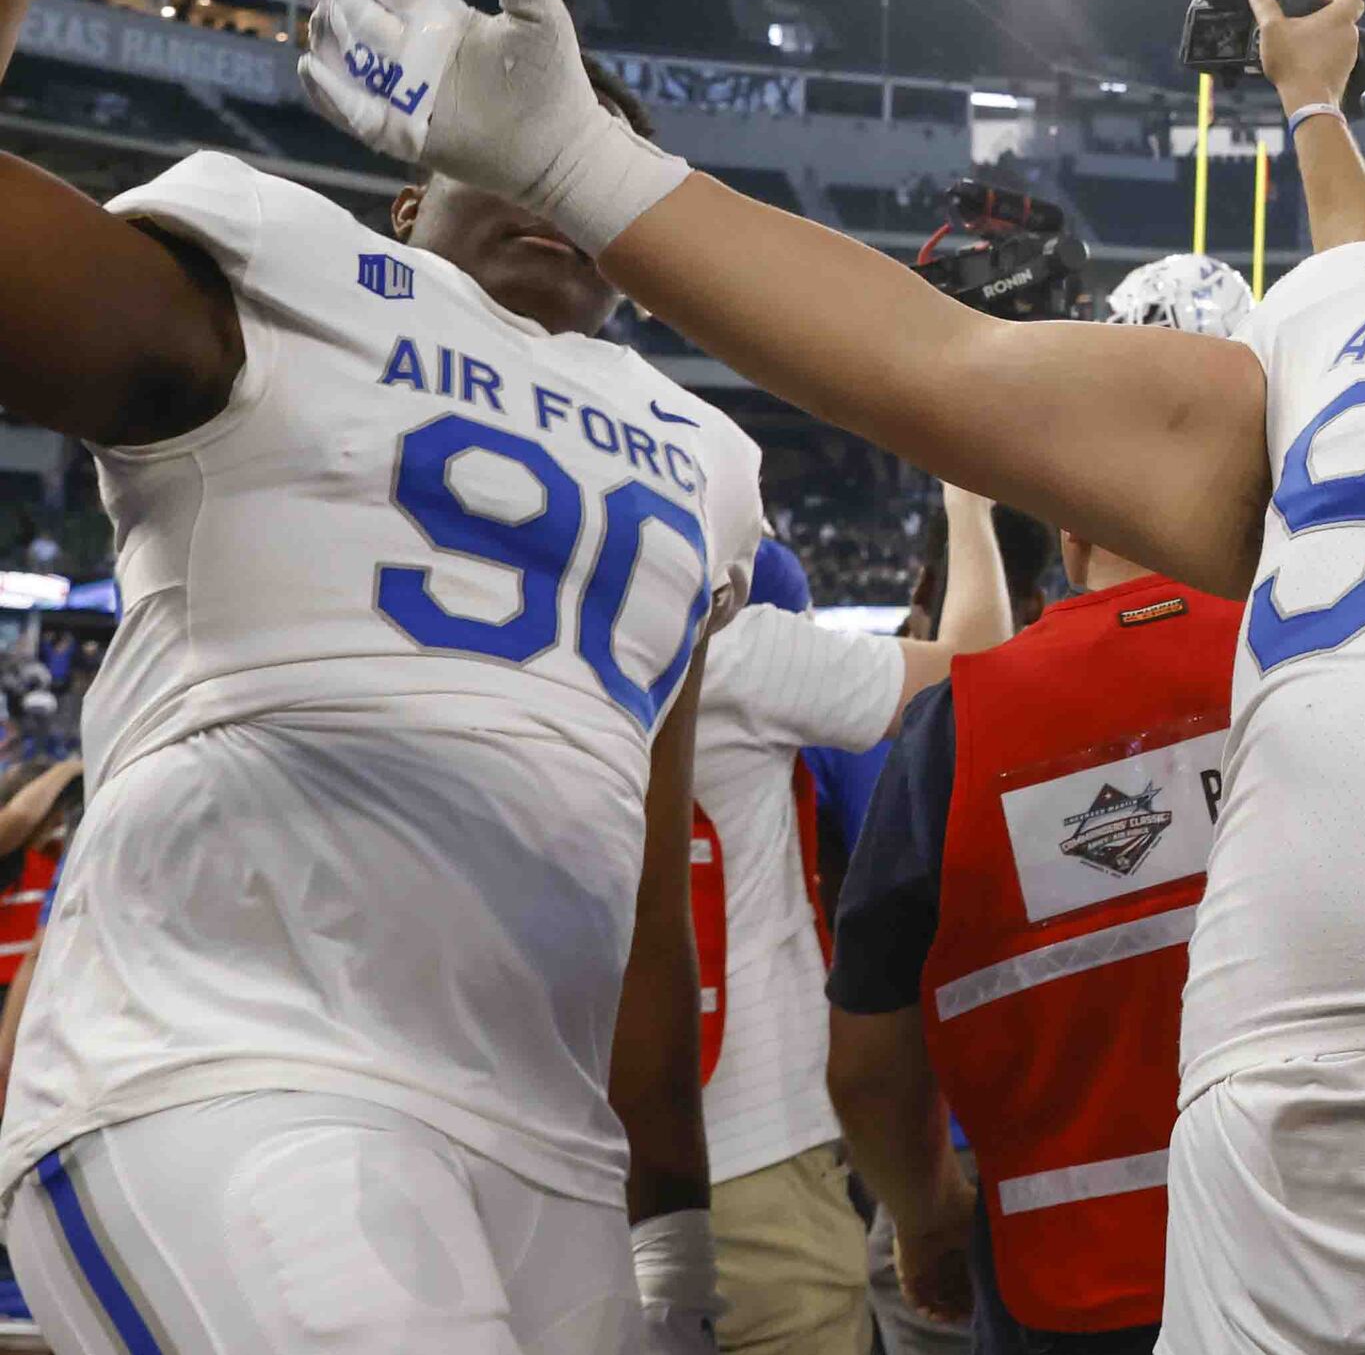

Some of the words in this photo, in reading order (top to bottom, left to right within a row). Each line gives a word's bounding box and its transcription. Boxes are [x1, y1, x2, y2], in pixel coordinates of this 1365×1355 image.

[123, 28, 275, 94] RANGERS
[982, 268, 1033, 299] RONIN
[376, 335, 508, 415] AIR
[531, 381, 708, 498] FORC
[372, 410, 712, 733] 90
